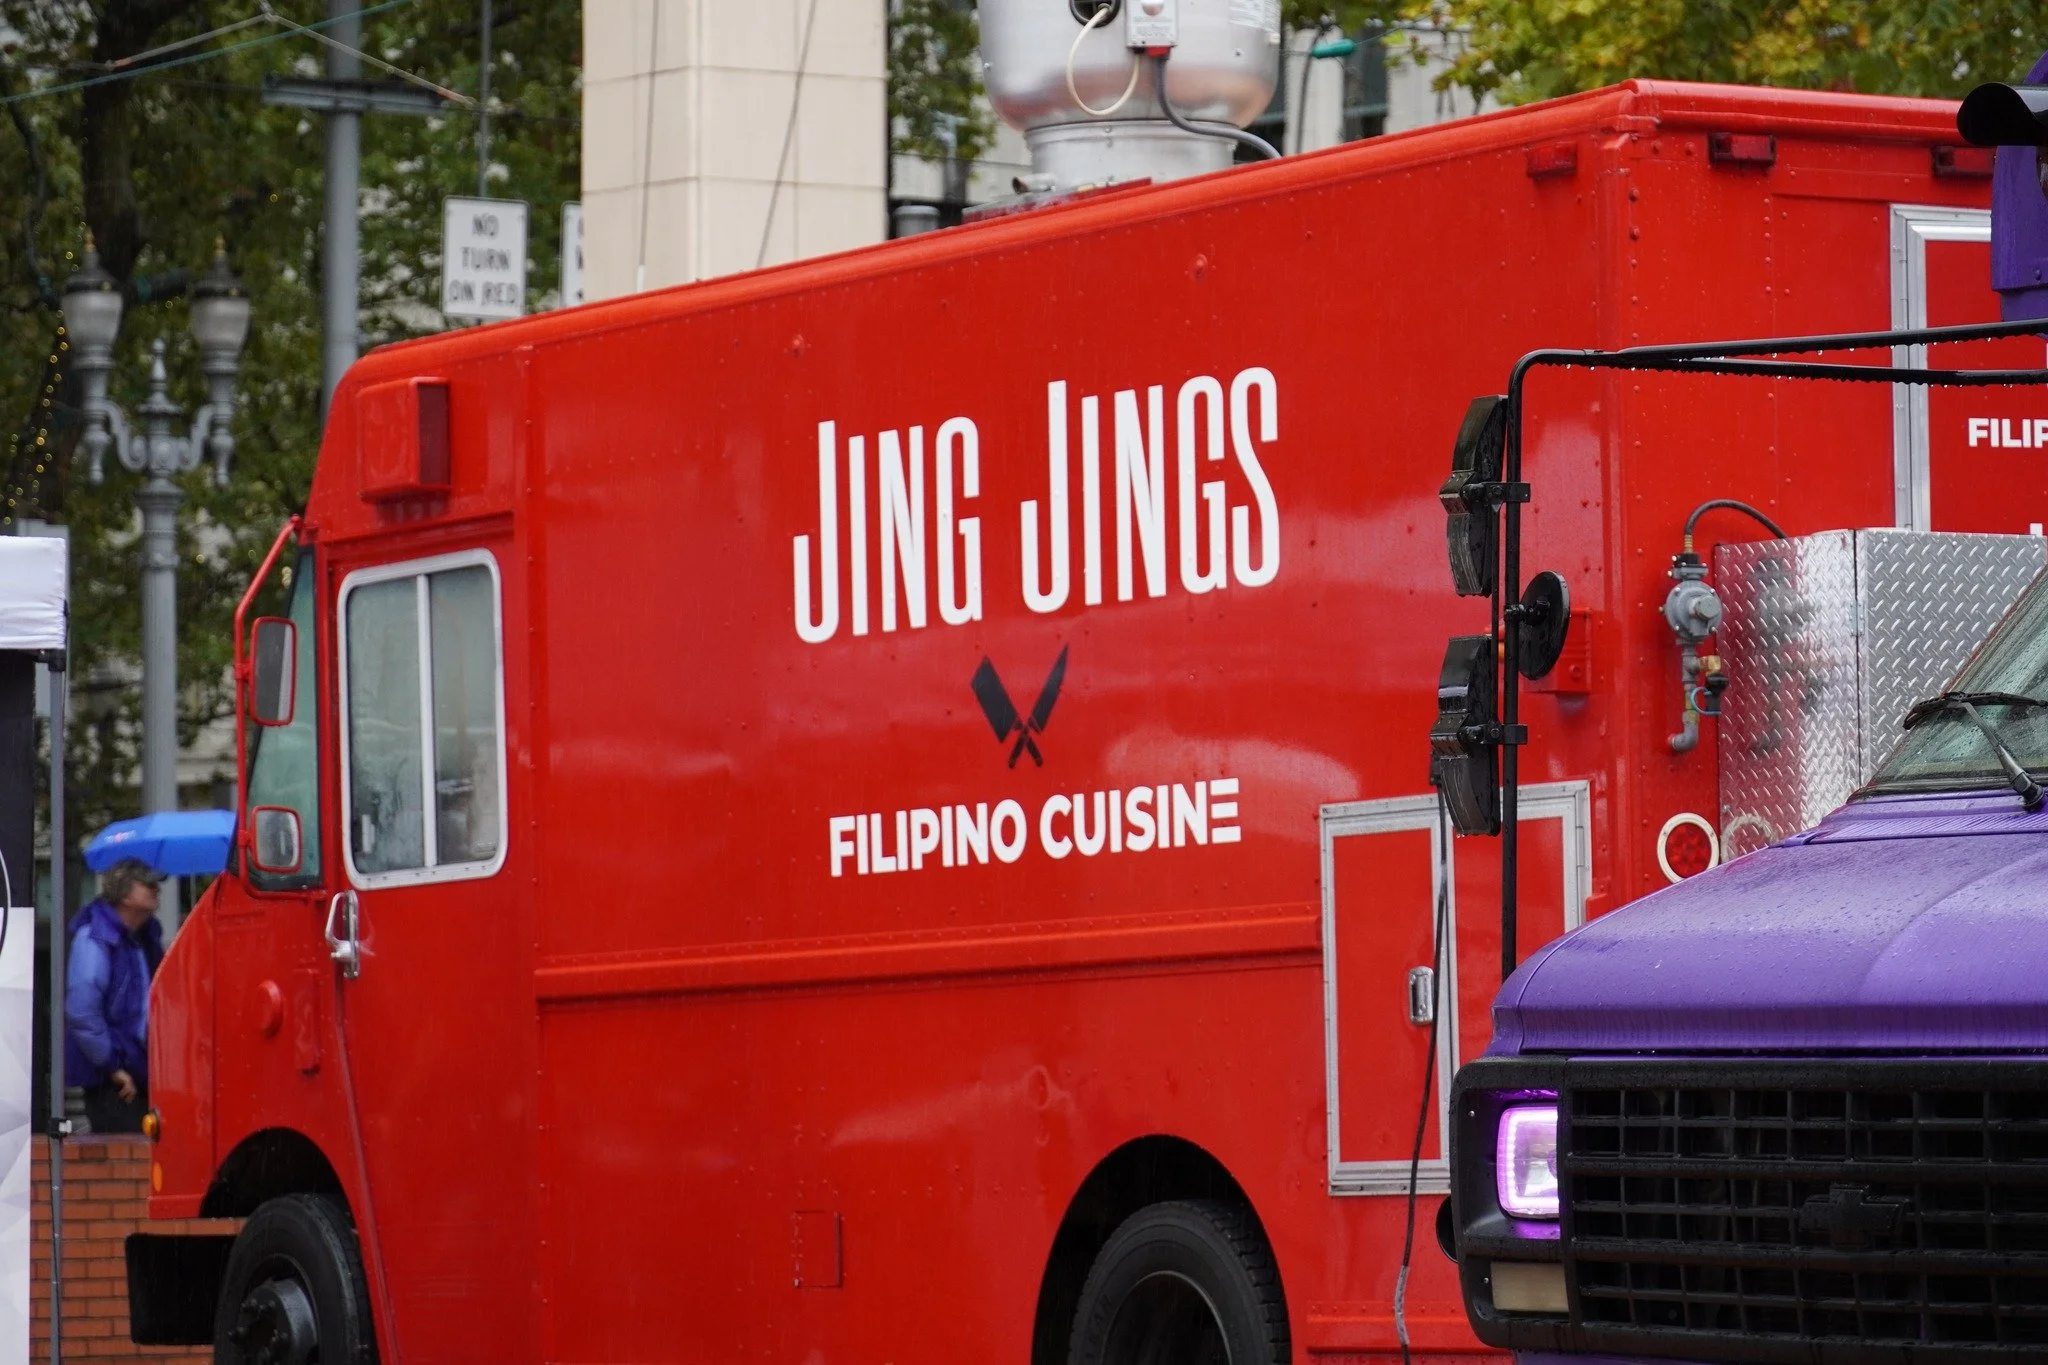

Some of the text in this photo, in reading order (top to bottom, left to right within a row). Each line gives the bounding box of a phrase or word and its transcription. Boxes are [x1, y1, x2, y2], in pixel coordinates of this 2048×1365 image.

[472, 214, 499, 237] NO
[462, 246, 510, 271] TURN
[449, 279, 519, 306] ON RED
[793, 367, 1281, 643] JING JINGS
[829, 777, 1242, 877] FILIPINO CUISINE
